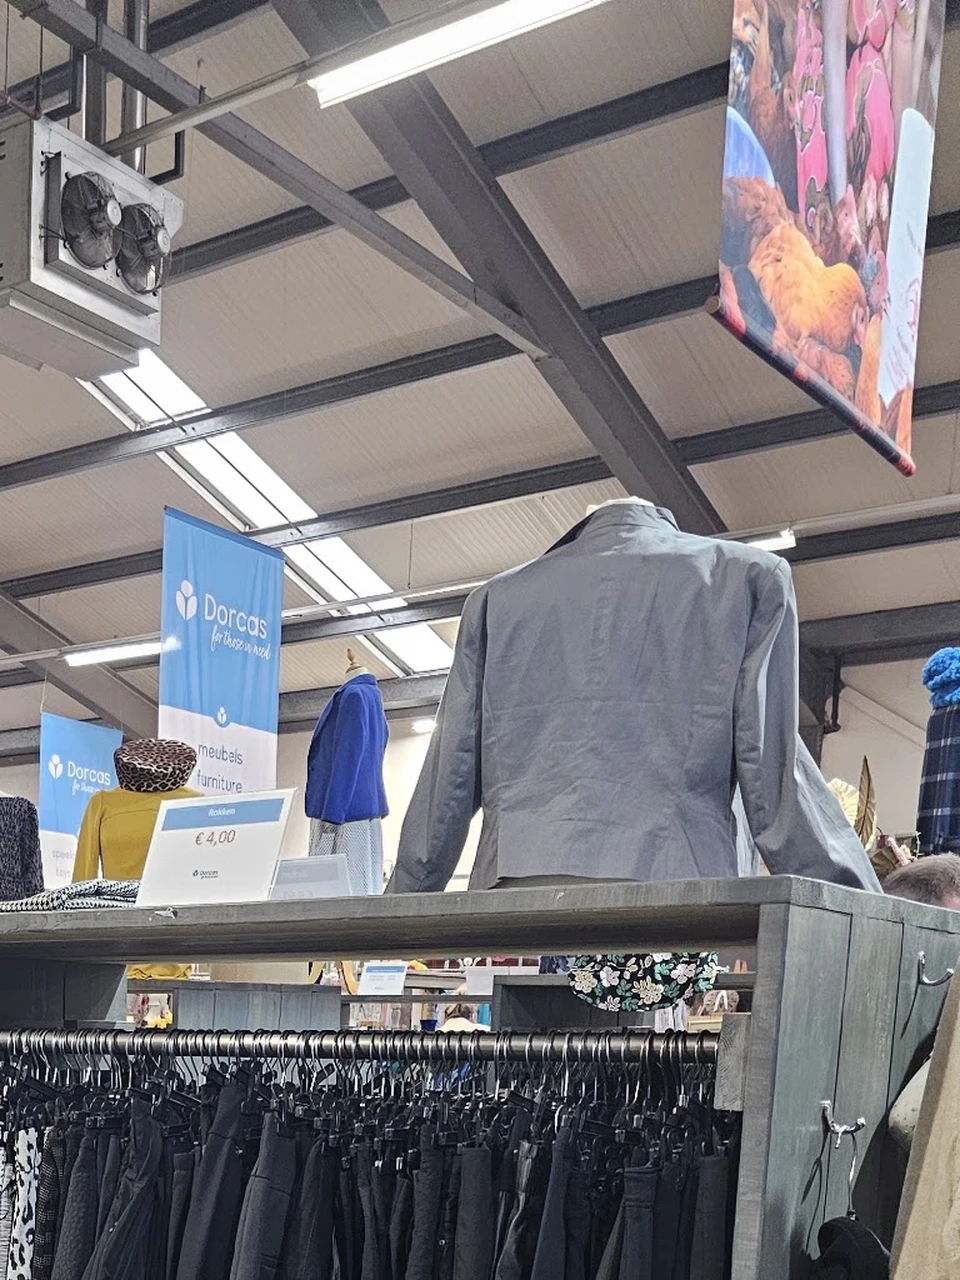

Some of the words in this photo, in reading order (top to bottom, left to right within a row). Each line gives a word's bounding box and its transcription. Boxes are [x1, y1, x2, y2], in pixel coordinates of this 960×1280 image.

[204, 593, 268, 640] Dorcas
[210, 624, 223, 652] for
[198, 744, 244, 765] meubels
[67, 760, 111, 786] Dorcas
[197, 769, 243, 794] furniture
[208, 807, 236, 817] Rokken
[195, 831, 204, 846] €
[205, 829, 236, 847] 4,00
